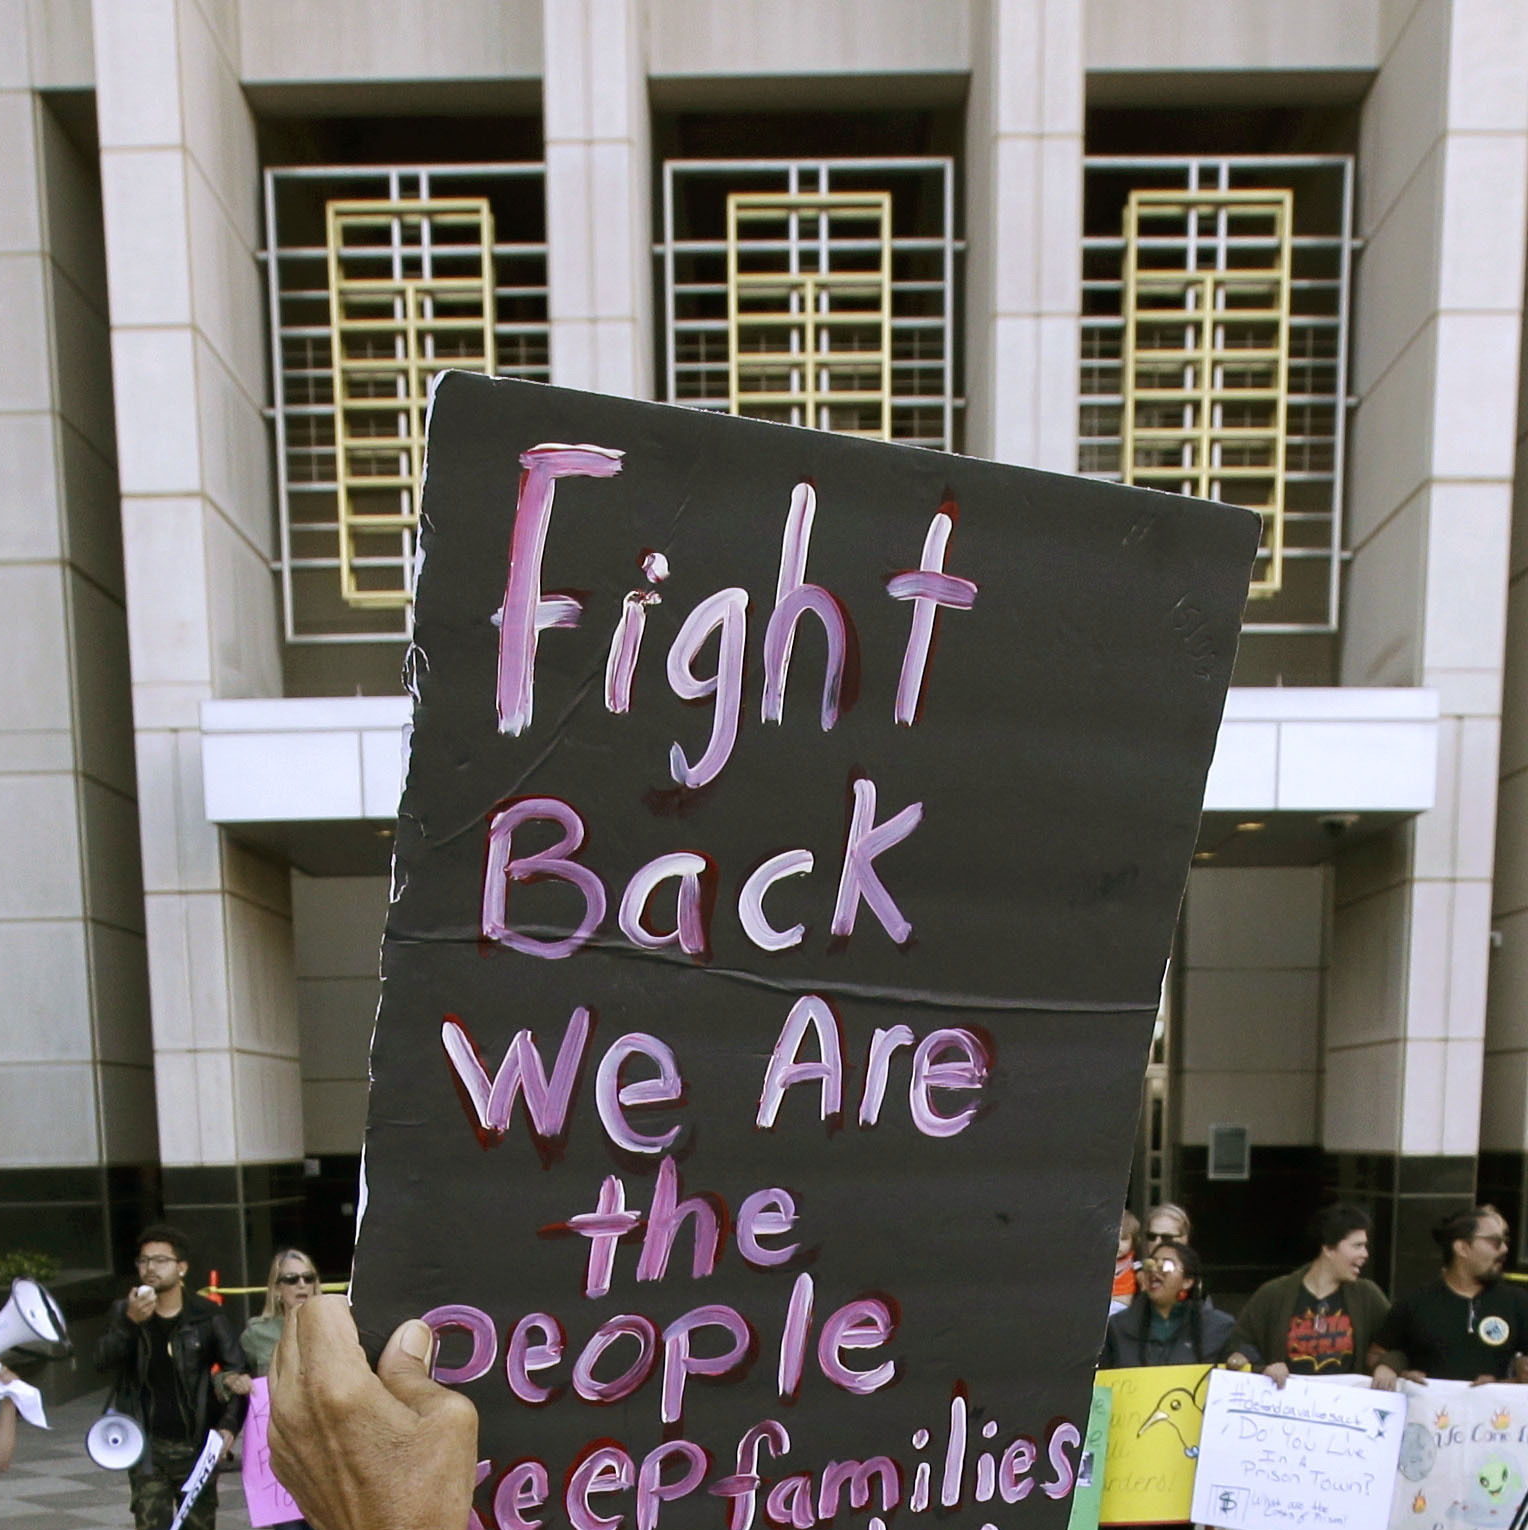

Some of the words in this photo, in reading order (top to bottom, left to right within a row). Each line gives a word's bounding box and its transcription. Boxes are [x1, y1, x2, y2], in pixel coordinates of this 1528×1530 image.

[491, 443, 980, 788] Fight
[480, 776, 924, 960] Back
[441, 1004, 684, 1158] We
[755, 994, 992, 1140] Are
[557, 1155, 802, 1298] the
[1237, 1415, 1268, 1442] Do
[1240, 1459, 1301, 1485] Prison
[1310, 1469, 1376, 1496] Town?
